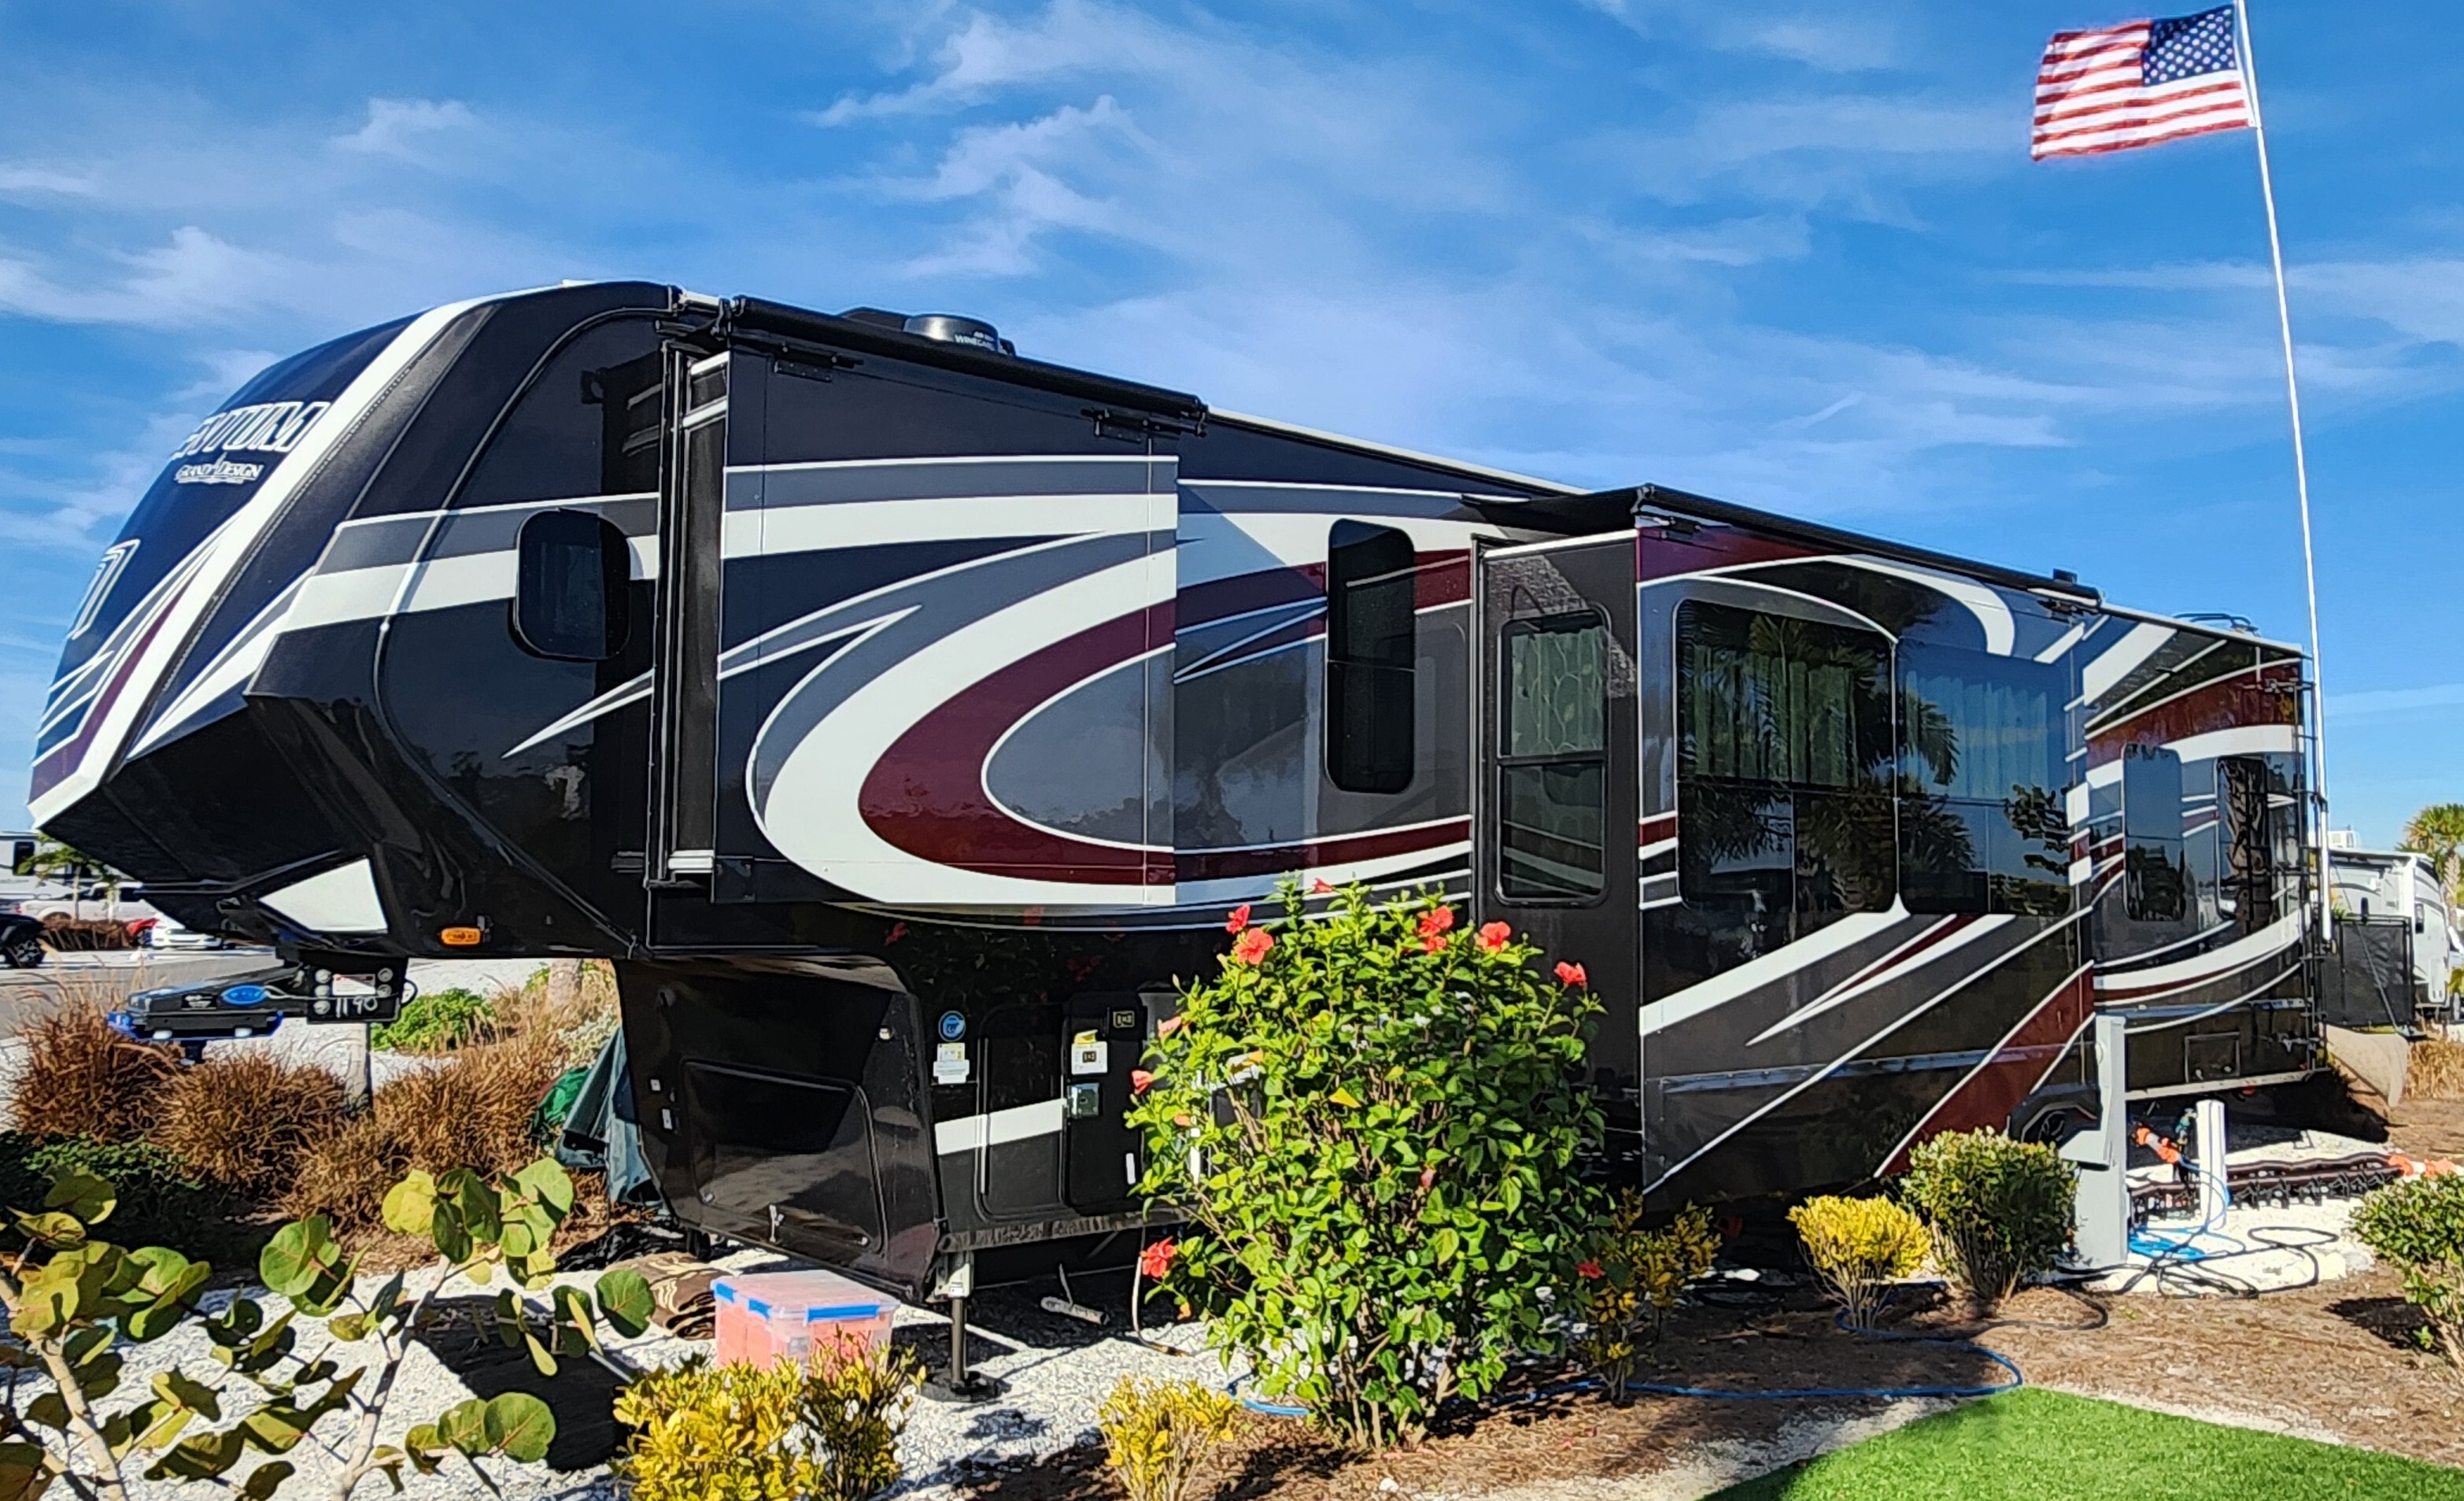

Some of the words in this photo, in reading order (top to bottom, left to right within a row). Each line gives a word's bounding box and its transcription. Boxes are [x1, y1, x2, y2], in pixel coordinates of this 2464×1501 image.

[170, 401, 331, 460] ENTUM
[175, 464, 215, 478] GRAND
[216, 461, 264, 478] DESIGN
